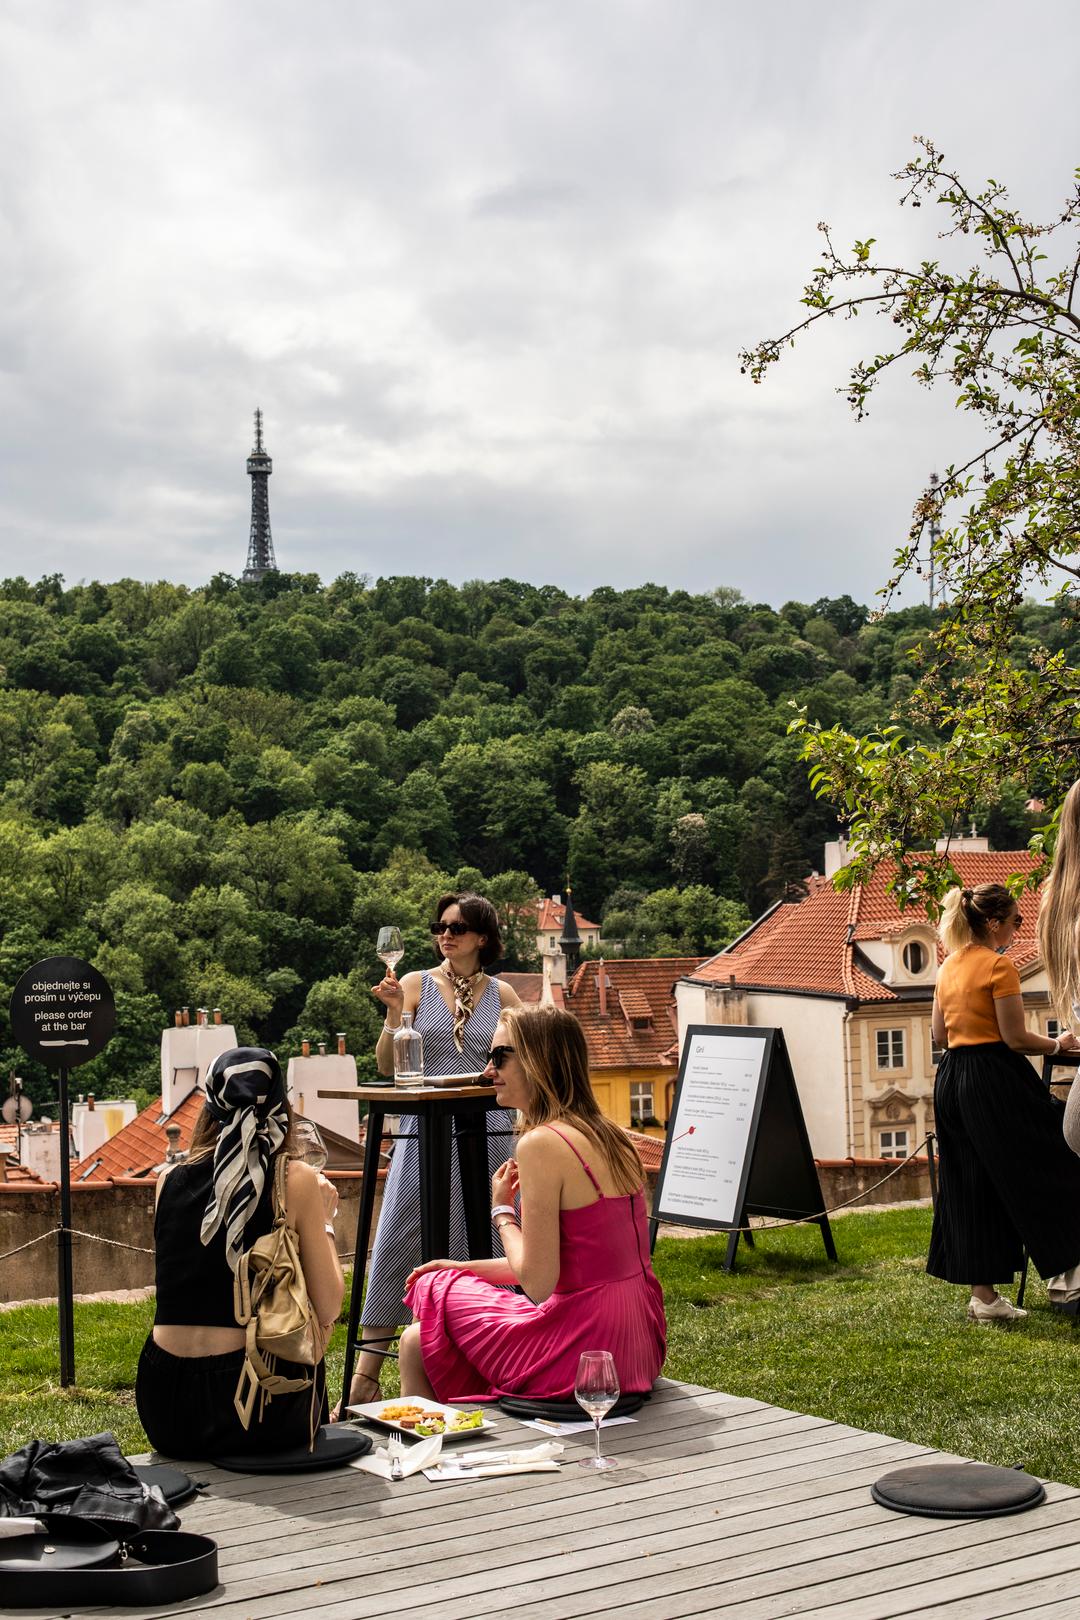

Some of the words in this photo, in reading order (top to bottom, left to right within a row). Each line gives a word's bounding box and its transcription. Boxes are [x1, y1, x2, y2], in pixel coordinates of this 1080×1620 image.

[32, 981, 80, 992] objednejte
[83, 982, 91, 990] si
[24, 992, 57, 1004] prosím
[68, 991, 101, 1003] výčepu
[34, 1011, 65, 1022] please
[68, 1010, 92, 1019] order
[41, 1023, 51, 1031] at
[53, 1022, 68, 1030] the
[71, 1021, 86, 1030] bar
